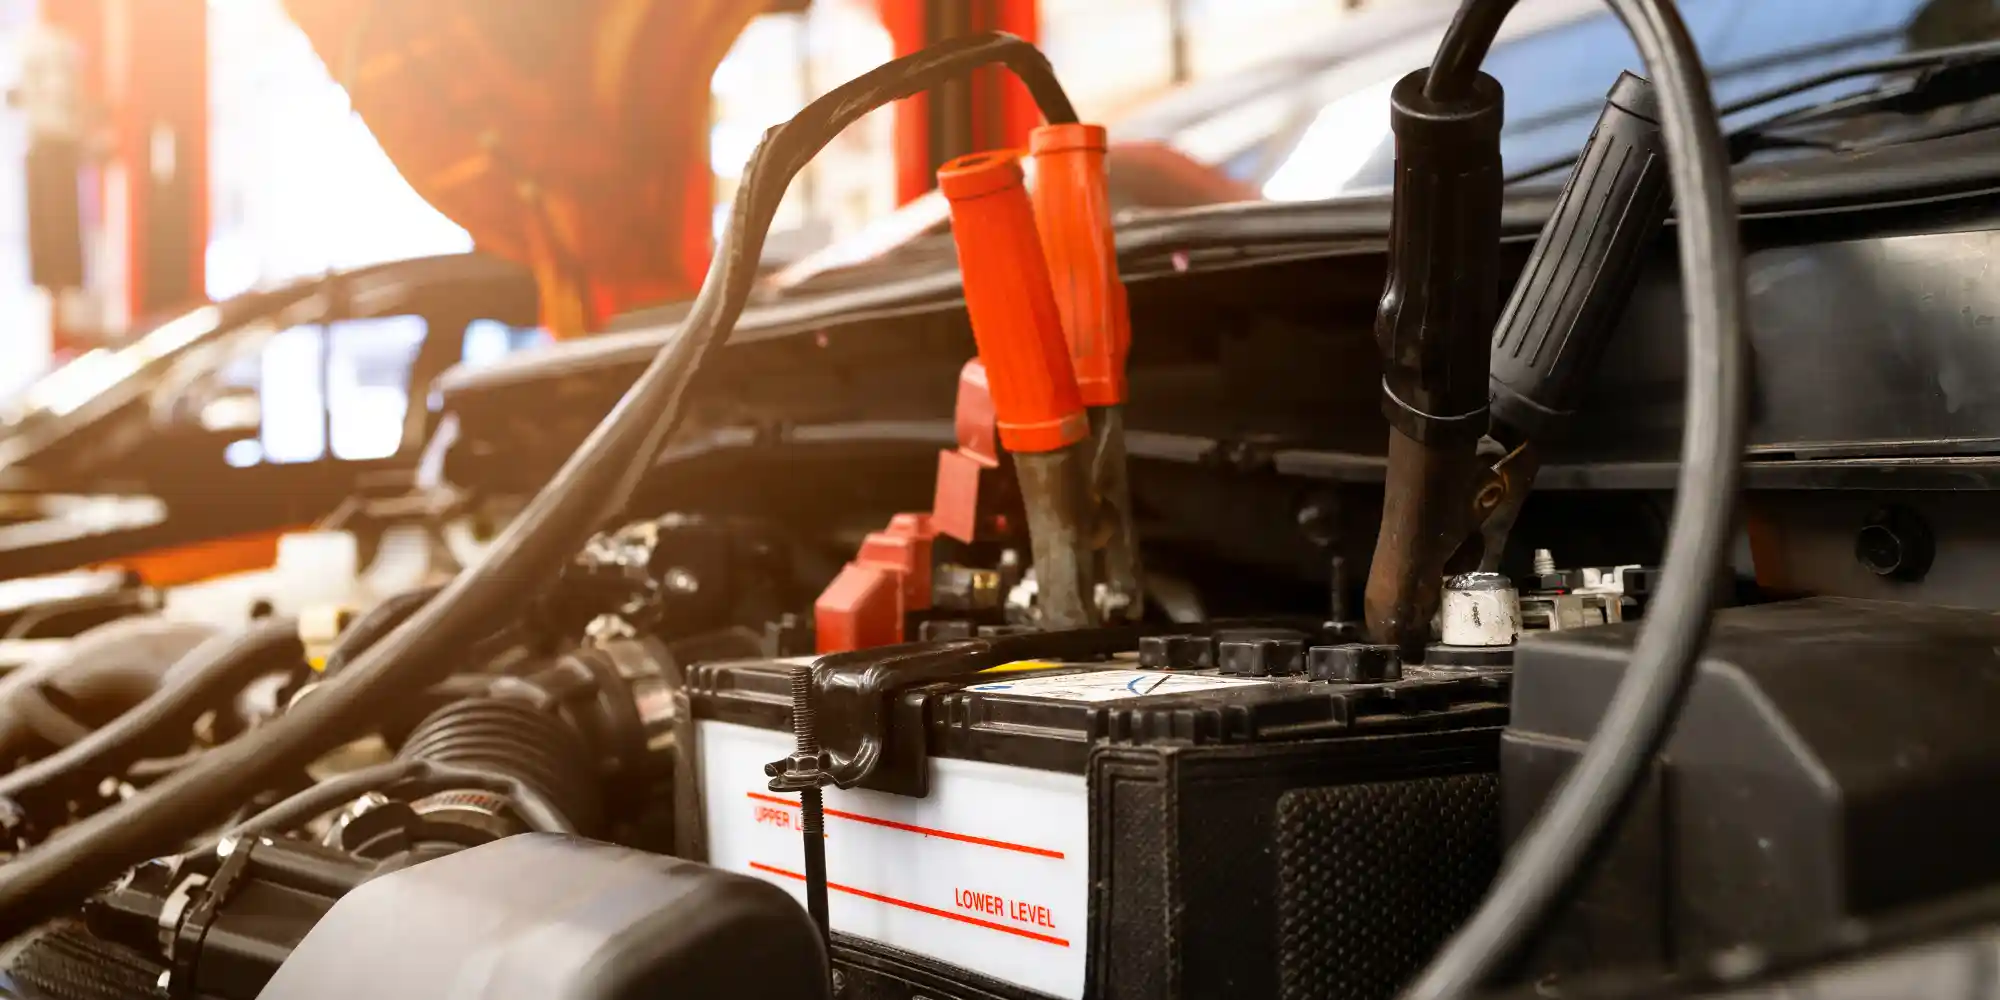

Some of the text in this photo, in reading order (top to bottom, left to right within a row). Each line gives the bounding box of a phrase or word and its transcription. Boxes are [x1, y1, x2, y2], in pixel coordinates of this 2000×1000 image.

[754, 805, 790, 827] UPPER
[955, 887, 1056, 929] LOWER LEVEL
